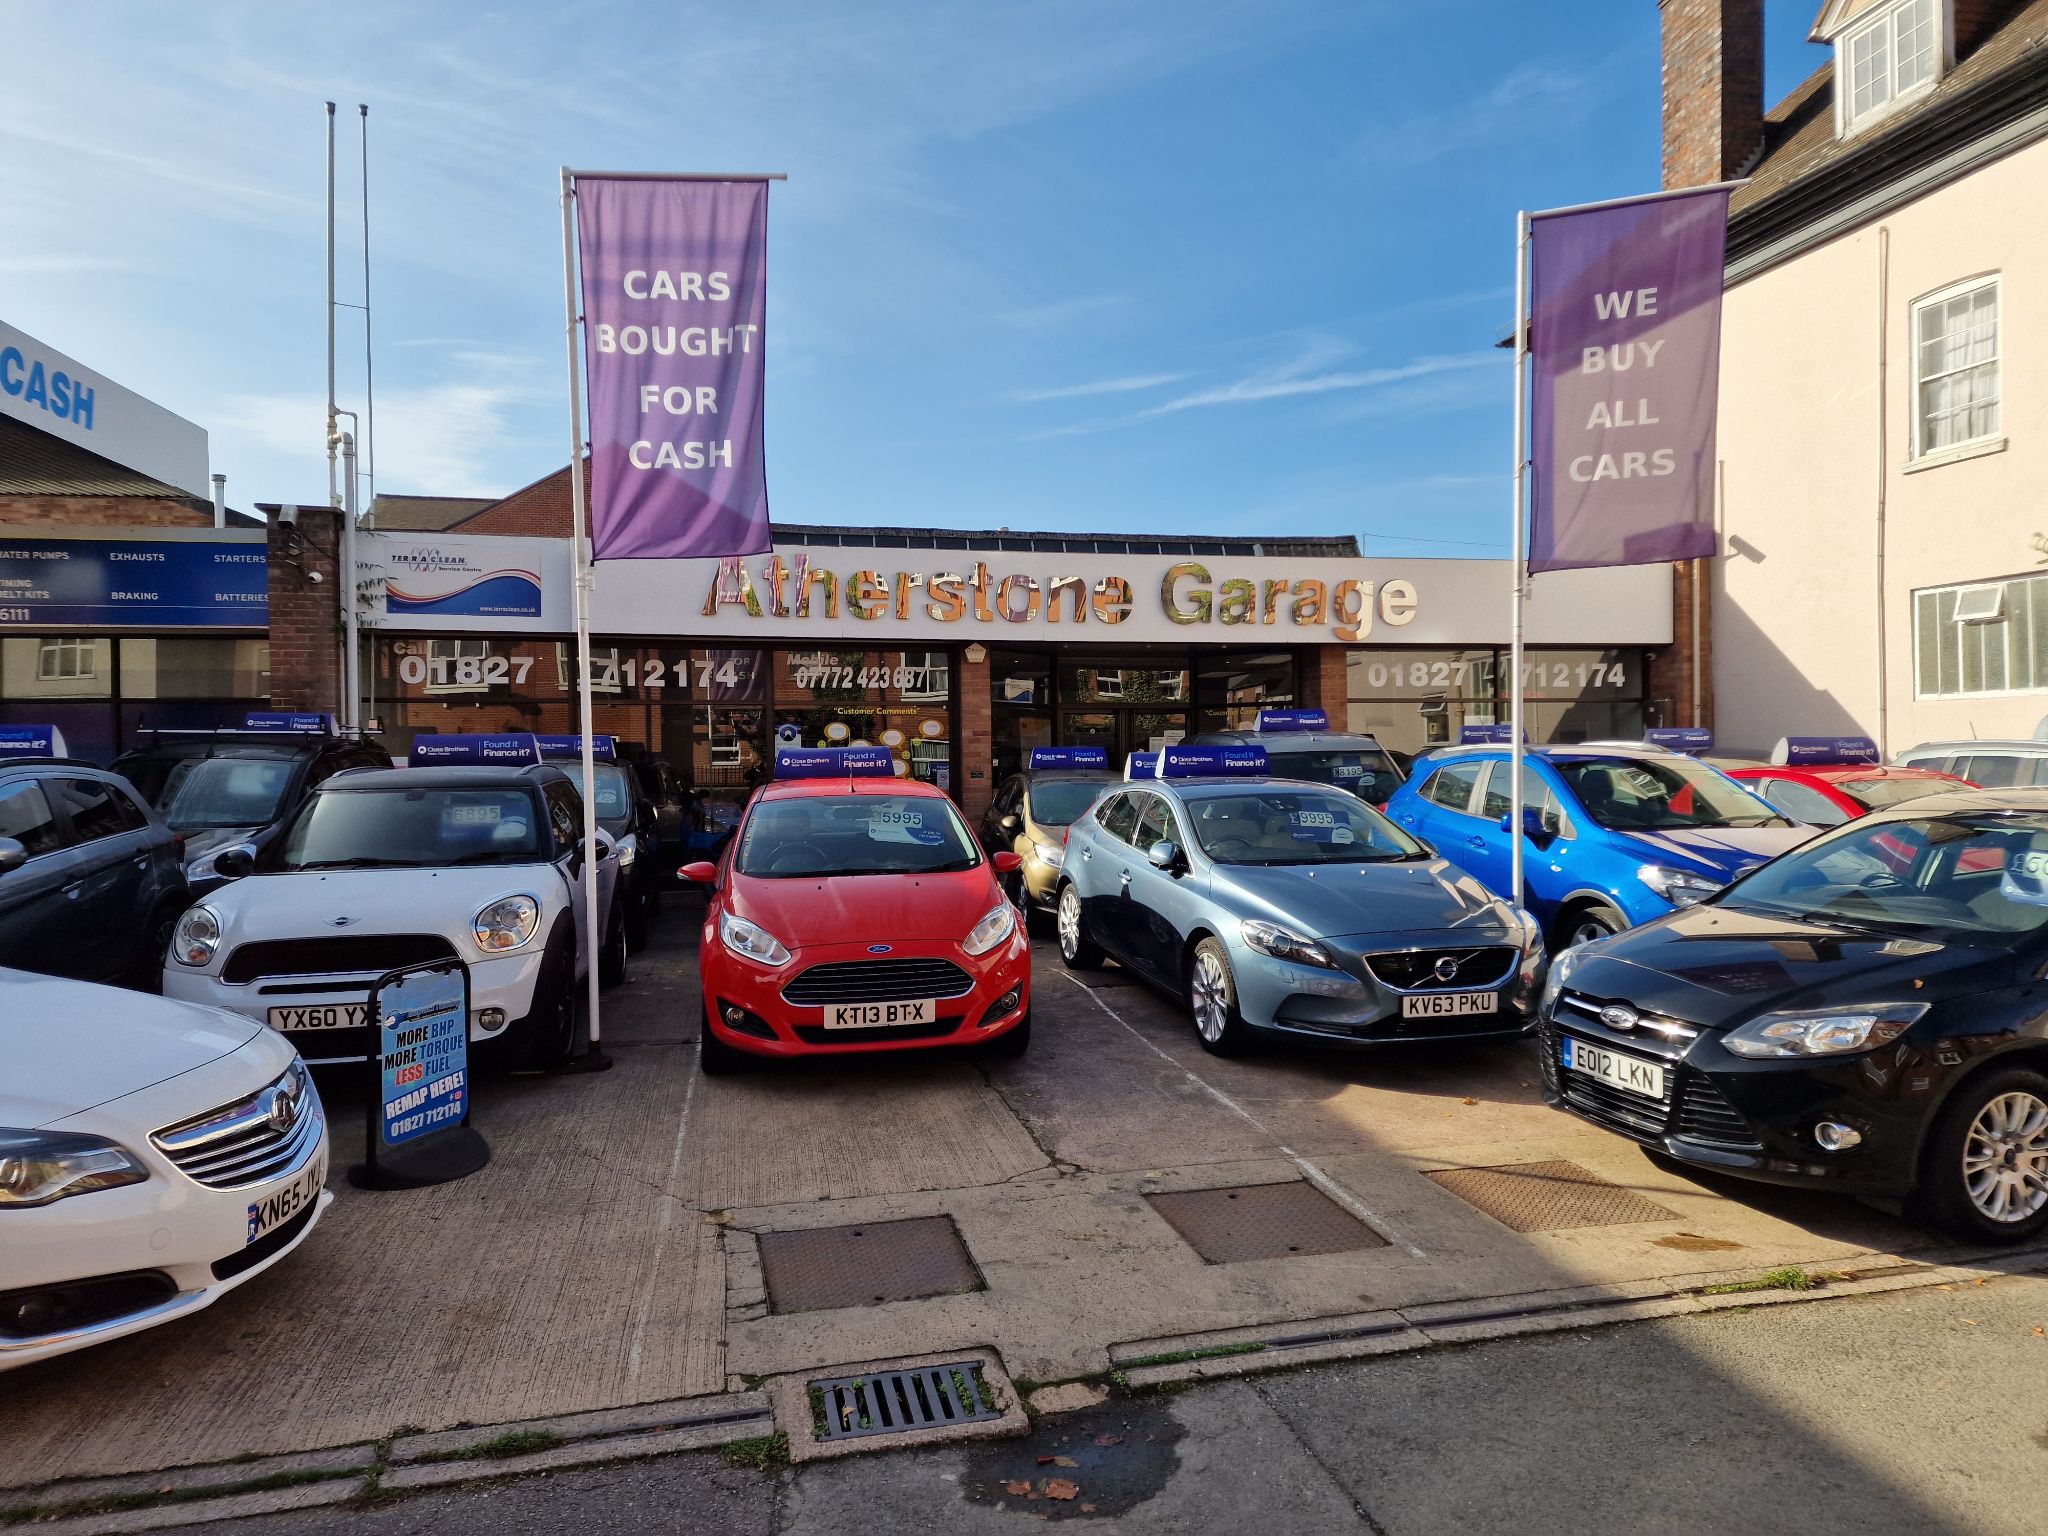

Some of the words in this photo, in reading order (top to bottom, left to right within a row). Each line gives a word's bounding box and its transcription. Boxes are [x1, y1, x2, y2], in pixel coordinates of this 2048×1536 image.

[623, 270, 731, 301] CARS
[1594, 287, 1658, 321] WE
[594, 323, 757, 356] BOUGHT
[1581, 339, 1666, 375] BUY
[0, 346, 95, 431] CASH
[640, 384, 718, 416] FOR
[1585, 397, 1660, 431] ALL
[628, 439, 733, 470] CASH
[1569, 448, 1676, 483] CARS
[32, 551, 70, 560] PUMPS
[110, 552, 165, 562] EXHAUSTS
[214, 554, 266, 563] STARTERS
[25, 590, 50, 599] KITS
[111, 591, 159, 601] BRAKING
[215, 593, 269, 602] BATTERIES
[701, 553, 1134, 626] Atherstone
[1160, 561, 1418, 642] Garage
[0, 608, 30, 621] 6111
[399, 655, 535, 685] 01827
[596, 658, 739, 688] 712174
[786, 653, 839, 666] Mobile
[796, 666, 854, 689] 07772
[856, 666, 891, 689] 423
[892, 666, 927, 689] 687
[1368, 661, 1470, 688] 01827
[483, 740, 511, 748] Found
[512, 740, 518, 748] it
[483, 749, 518, 757] Finance
[519, 748, 530, 757] it?
[843, 760, 875, 768] Finance
[876, 759, 887, 767] it?
[1225, 759, 1254, 767] Finance
[1255, 759, 1265, 767] it?
[1289, 812, 1333, 824] £9995
[2010, 853, 2048, 875] £6
[836, 1006, 880, 1025] KT13
[886, 1003, 924, 1022] BTX
[1409, 996, 1454, 1015] KV63
[1460, 994, 1491, 1012] PKU
[278, 1008, 337, 1029] YX60
[396, 1025, 429, 1048] MORE
[431, 1018, 455, 1039] BHP
[384, 1046, 418, 1071] MORE
[419, 1033, 464, 1060] TORQUE
[395, 1063, 424, 1087] LESS
[425, 1056, 450, 1076] FUEL
[1618, 1059, 1654, 1091] LKN
[385, 1086, 428, 1120] REMAP
[429, 1070, 464, 1099] HERE!
[390, 1113, 424, 1137] 01827
[425, 1101, 461, 1125] 712174
[255, 1180, 301, 1235] KN65
